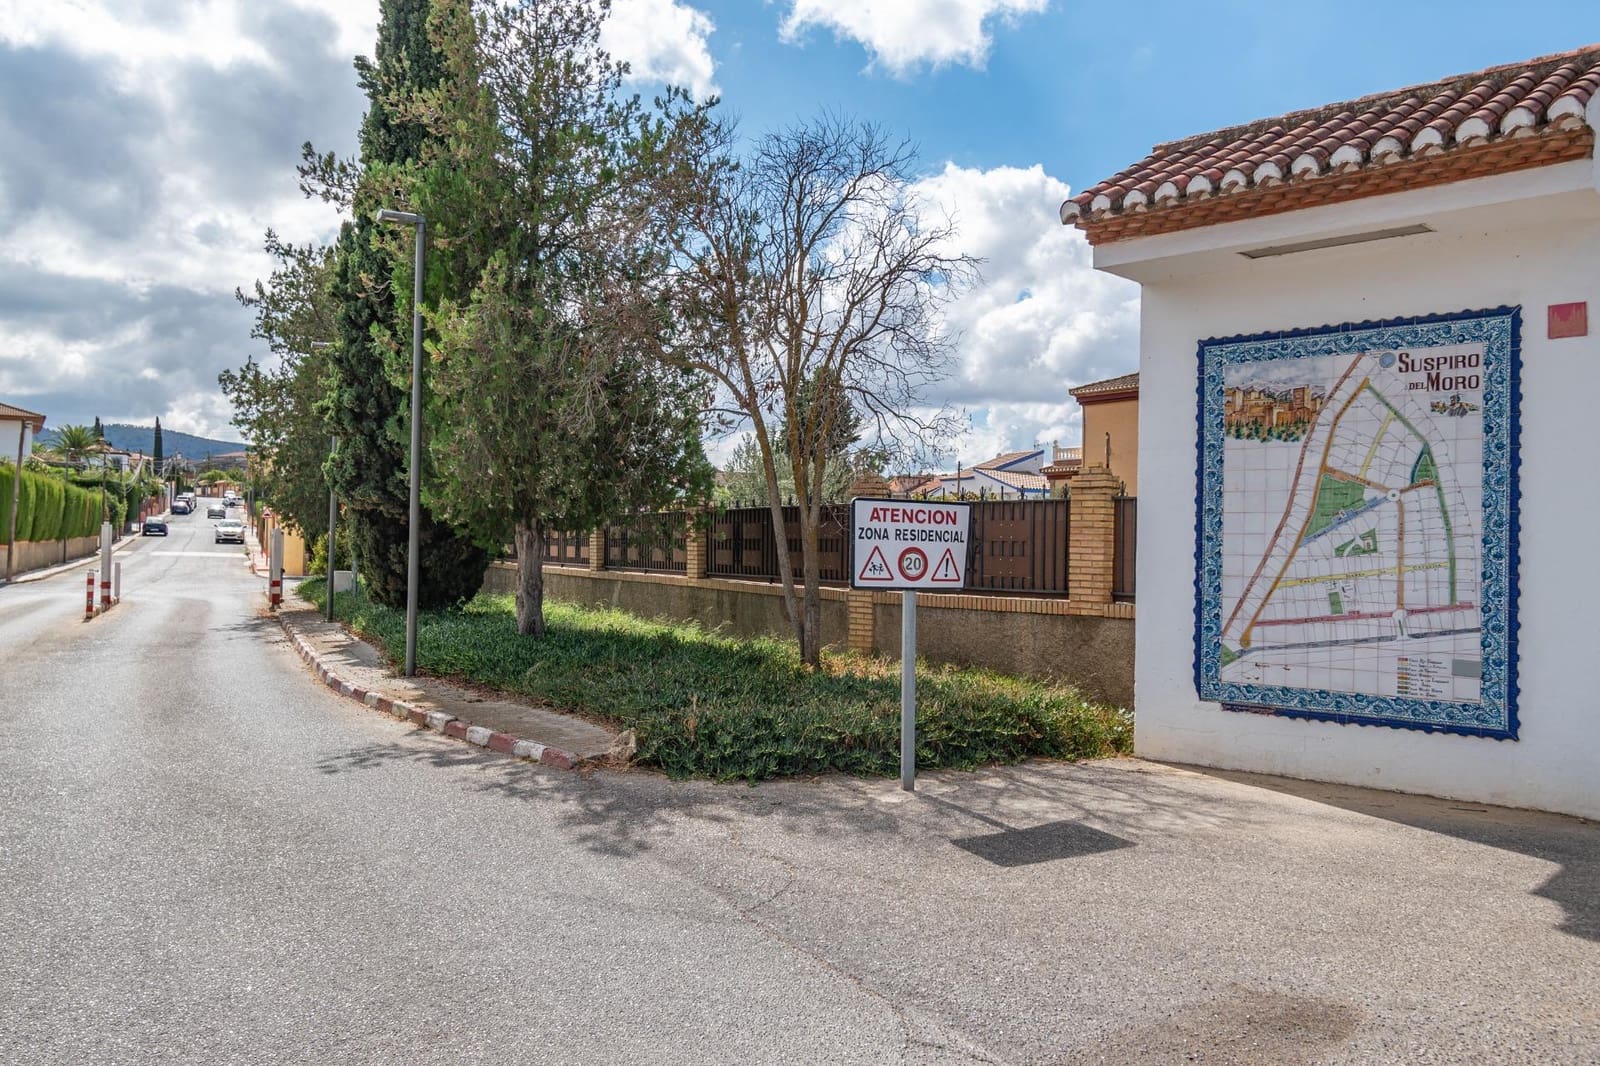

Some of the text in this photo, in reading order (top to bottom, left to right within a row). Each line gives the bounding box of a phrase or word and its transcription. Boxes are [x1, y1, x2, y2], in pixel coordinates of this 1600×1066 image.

[1398, 352, 1480, 373] SUSPIRO
[1409, 372, 1480, 392] DEL MORO
[869, 507, 957, 526] ATENCION
[858, 527, 965, 543] ZONA RESIDENCIAL
[905, 557, 921, 571] 20
